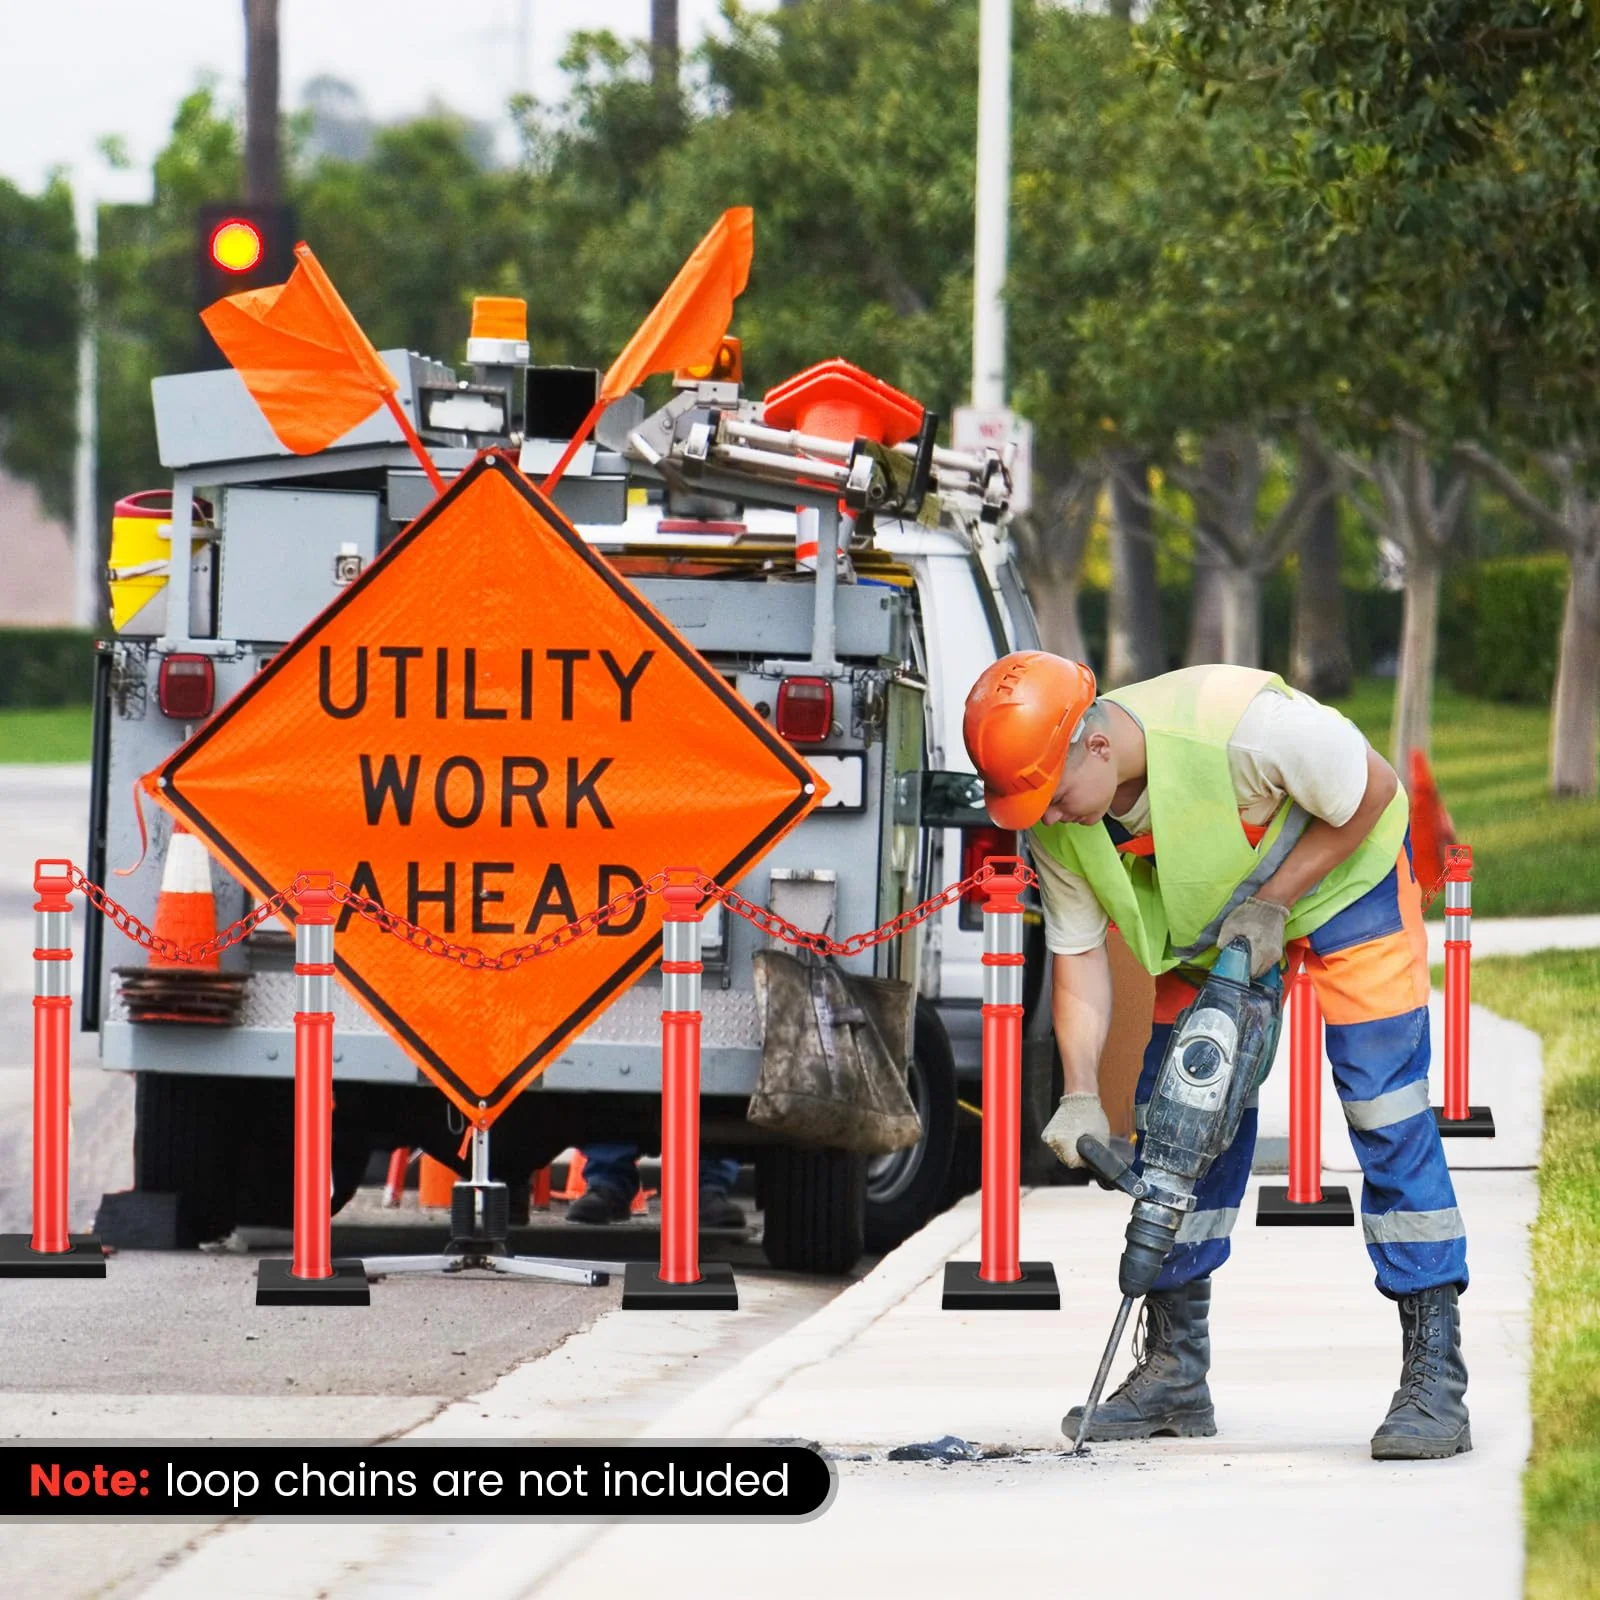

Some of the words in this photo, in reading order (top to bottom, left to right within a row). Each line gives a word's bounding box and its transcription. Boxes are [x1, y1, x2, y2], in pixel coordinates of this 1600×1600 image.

[319, 646, 655, 722] UTILITY
[359, 754, 615, 829] WORK
[335, 861, 648, 937] AHEAD
